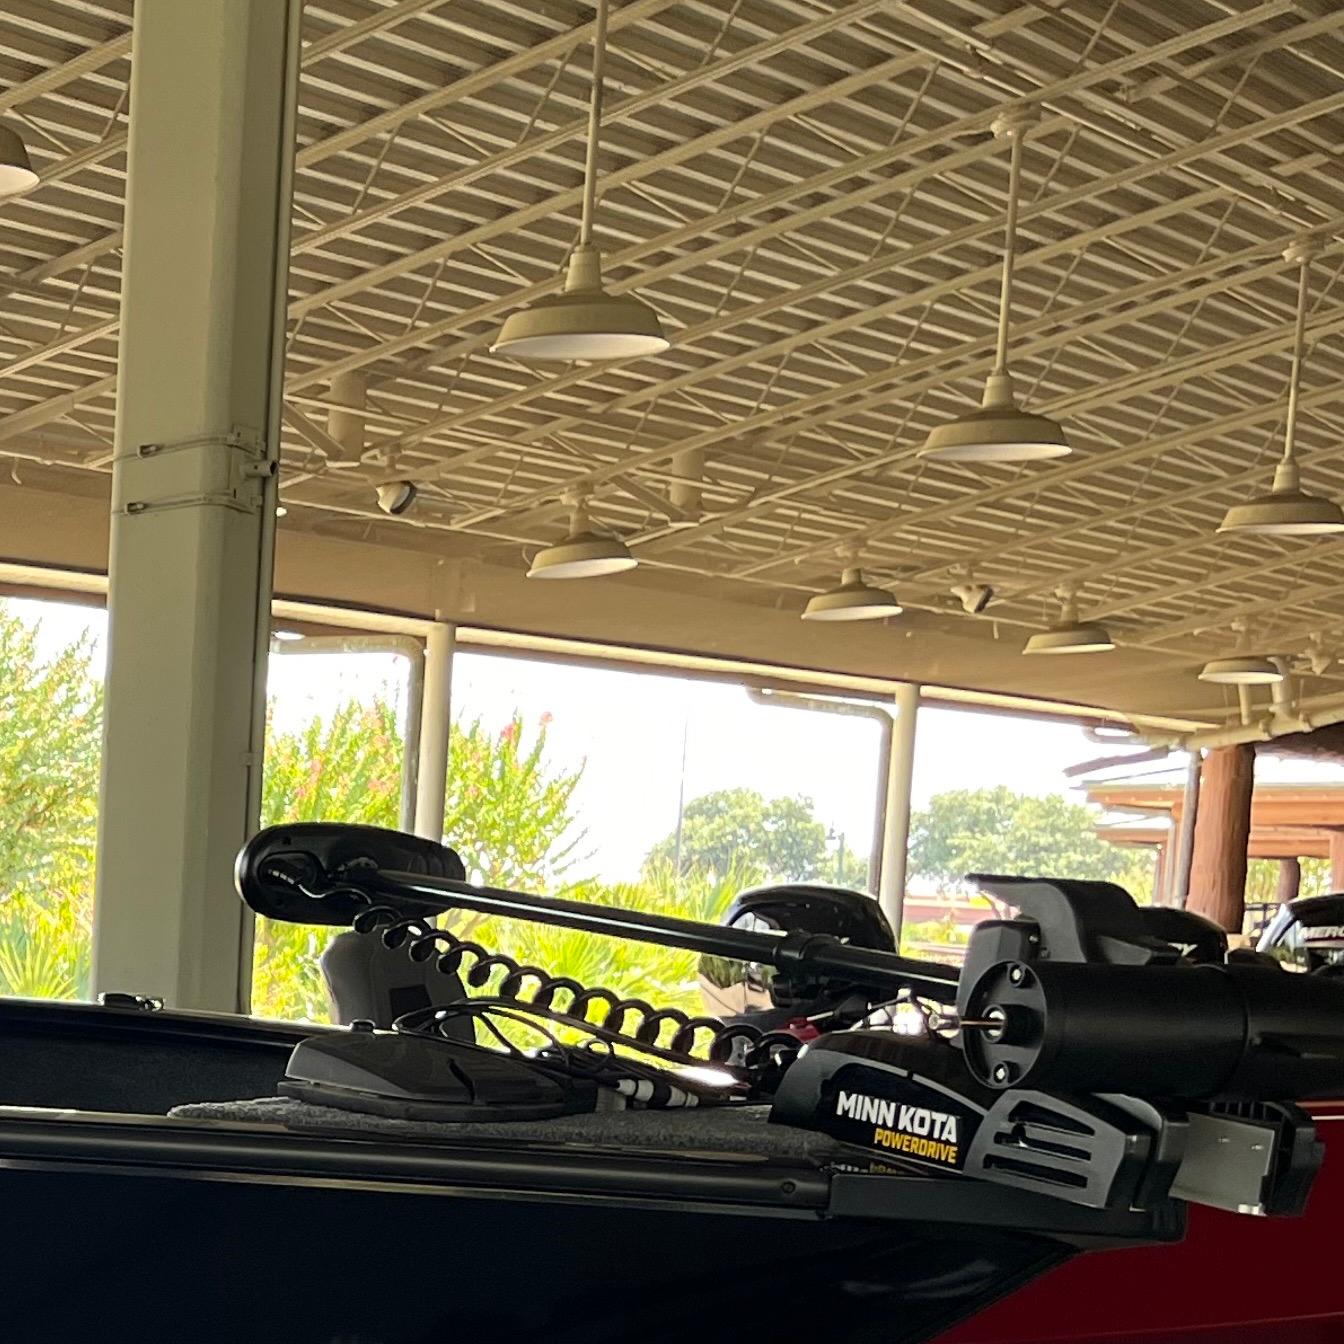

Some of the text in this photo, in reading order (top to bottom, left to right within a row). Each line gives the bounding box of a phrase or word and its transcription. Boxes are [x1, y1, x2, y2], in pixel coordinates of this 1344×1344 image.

[836, 1090, 958, 1143] MINN KOTA
[874, 1128, 958, 1164] POWERDRIVE
